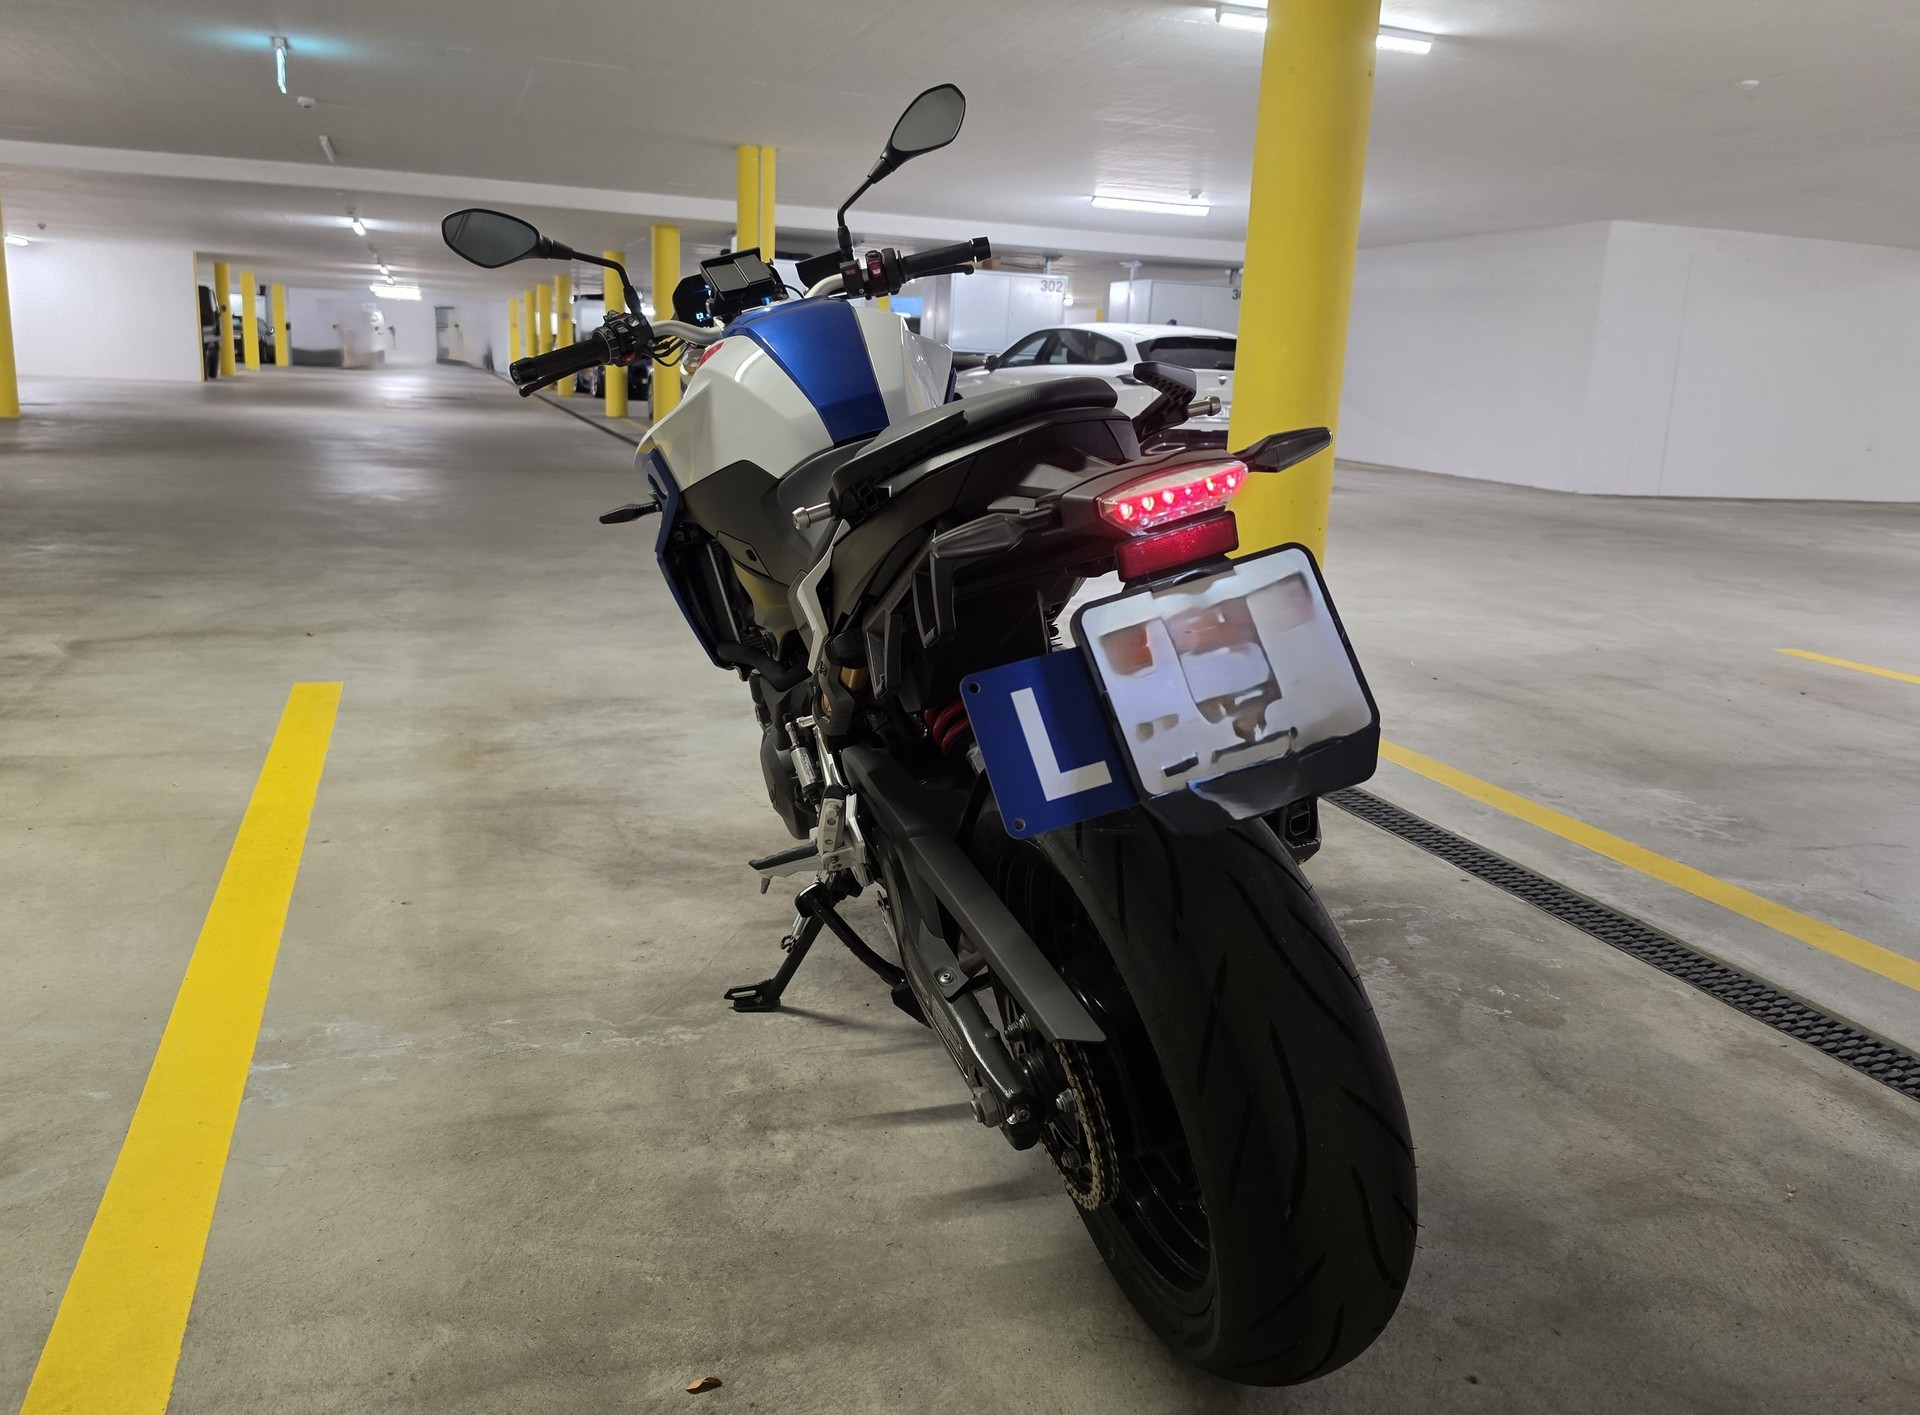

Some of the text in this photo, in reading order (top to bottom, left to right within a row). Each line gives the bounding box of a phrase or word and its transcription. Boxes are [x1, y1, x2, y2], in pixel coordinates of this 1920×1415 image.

[1040, 279, 1064, 293] 302
[1231, 288, 1241, 301] 3
[1011, 687, 1113, 802] L
